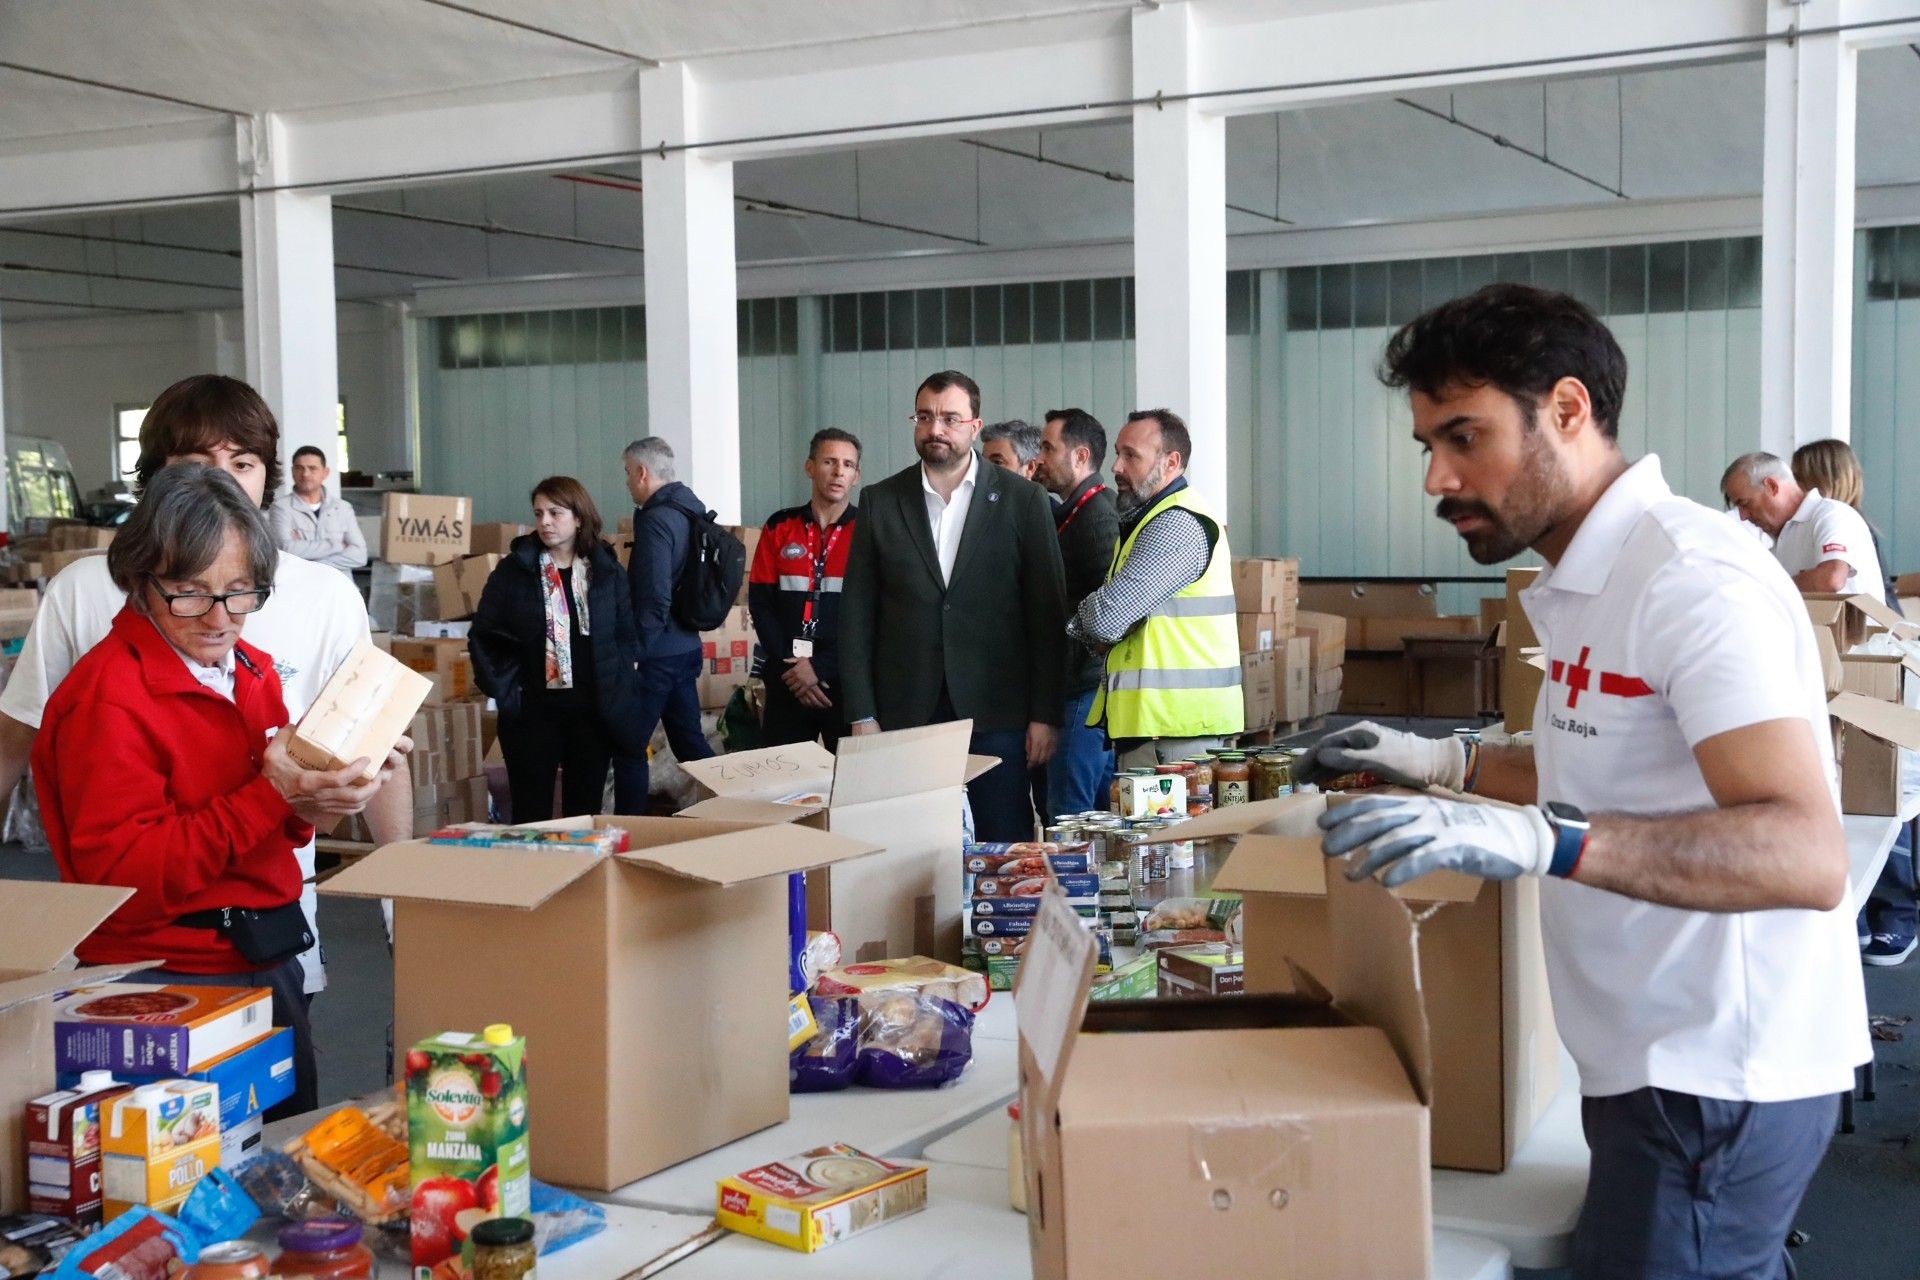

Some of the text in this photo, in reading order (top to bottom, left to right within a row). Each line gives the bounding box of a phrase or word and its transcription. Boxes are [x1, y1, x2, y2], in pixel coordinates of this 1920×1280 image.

[398, 515, 463, 539] YMÁS
[1568, 719, 1598, 738] Roja
[710, 753, 800, 780] ZUMOS
[1219, 975, 1233, 984] Don
[427, 1088, 482, 1106] Solevita
[427, 1142, 483, 1161] MANZANA
[169, 1158, 205, 1190] POLLO
